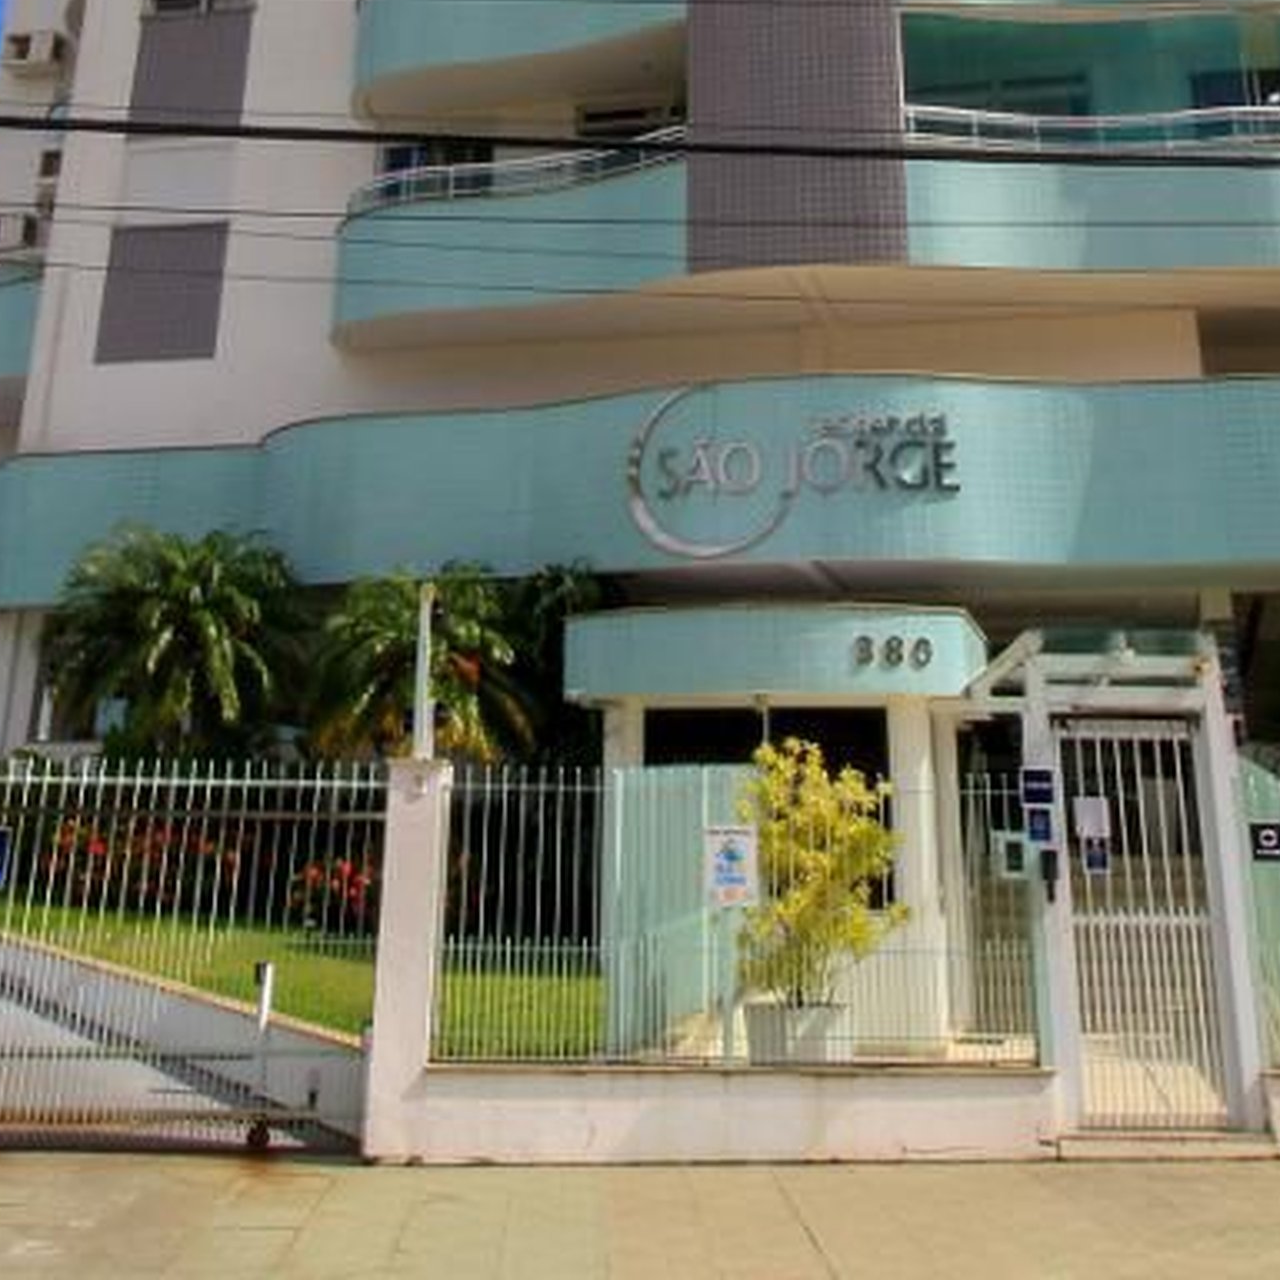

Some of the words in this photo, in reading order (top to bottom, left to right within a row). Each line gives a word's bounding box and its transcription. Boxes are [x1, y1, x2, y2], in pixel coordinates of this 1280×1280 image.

[657, 433, 761, 499] SÃO
[780, 437, 962, 497] JORGE
[852, 634, 934, 668] 380
